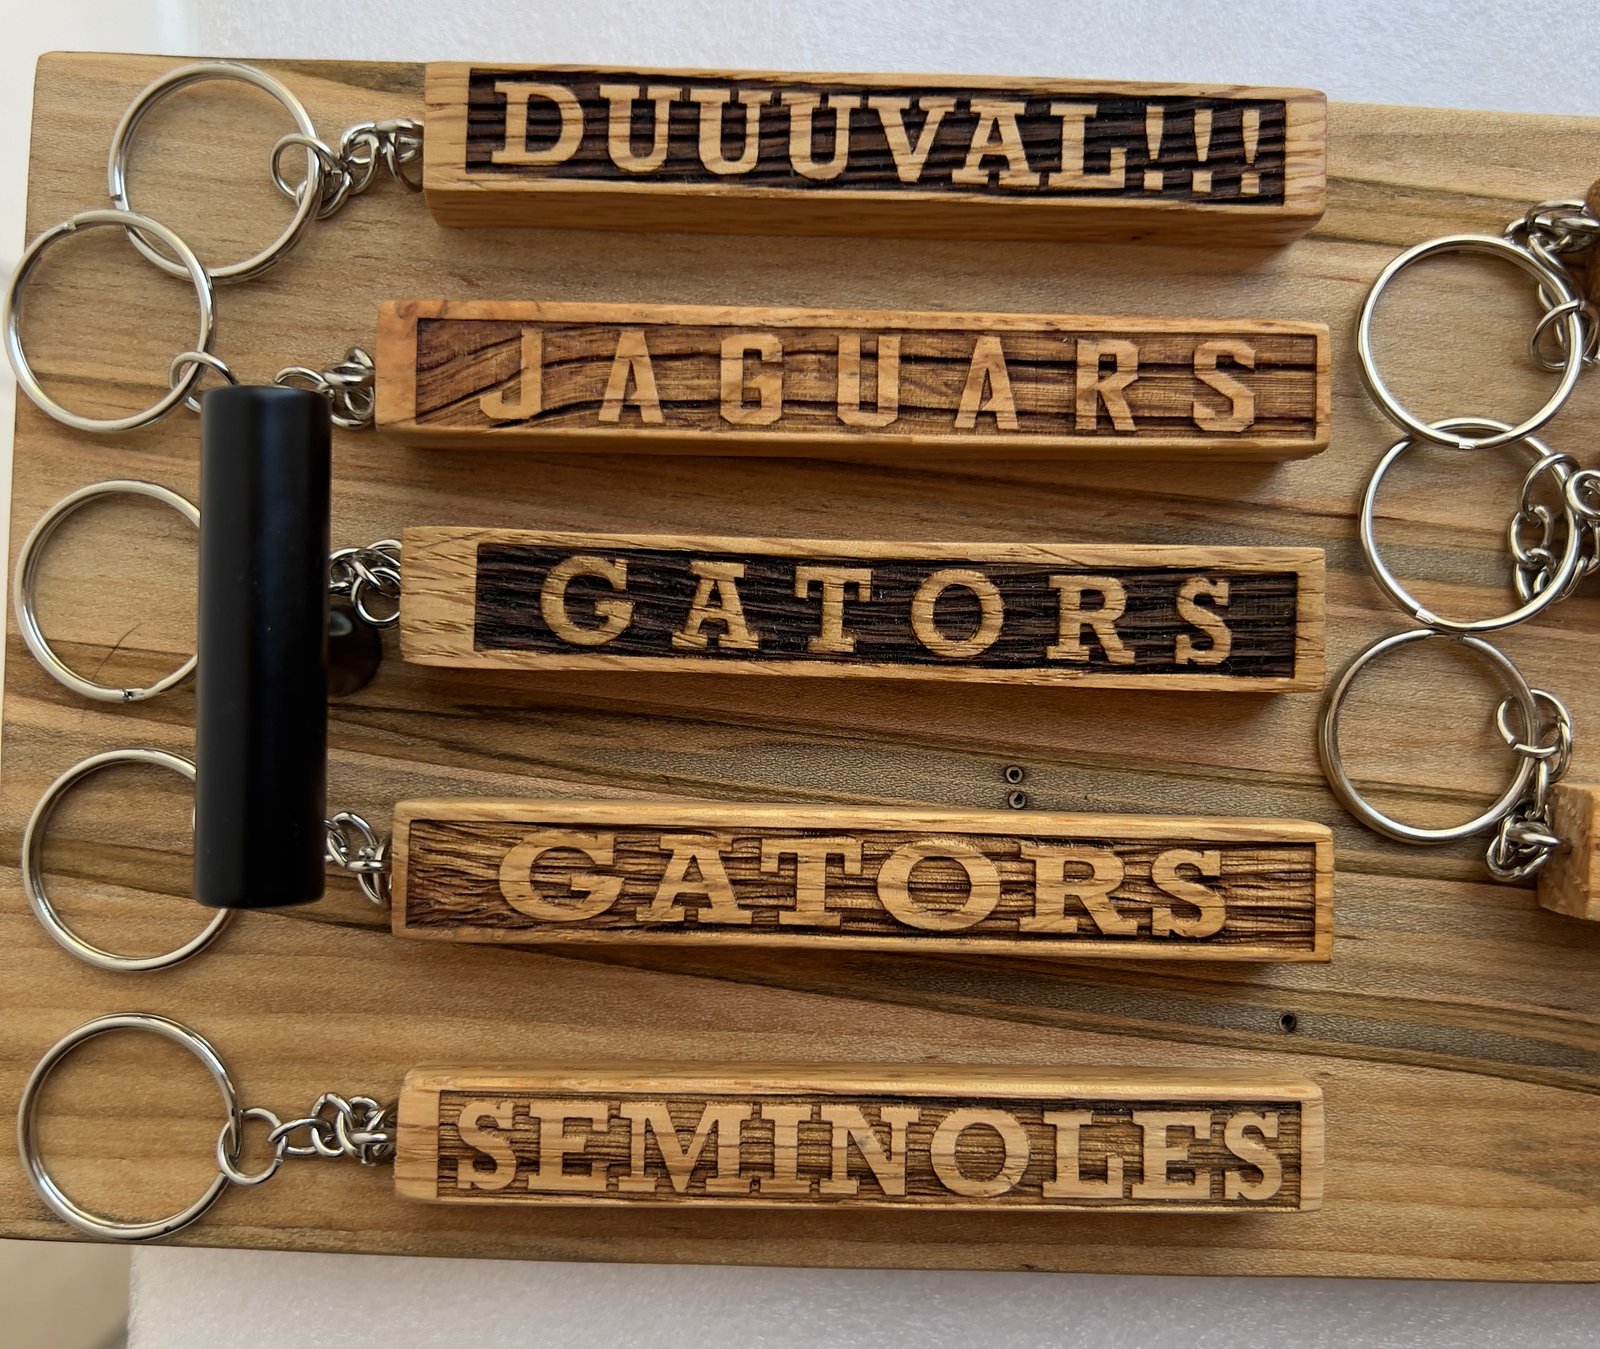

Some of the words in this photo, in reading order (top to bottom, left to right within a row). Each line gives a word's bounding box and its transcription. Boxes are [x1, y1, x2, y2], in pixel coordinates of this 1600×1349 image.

[490, 80, 1261, 196] DUUUVAL!!!
[478, 327, 1257, 434] JAGUARS
[540, 555, 1232, 666] GATORS
[497, 831, 1228, 938] GATORS
[457, 1100, 1281, 1202] SEMINOLES
